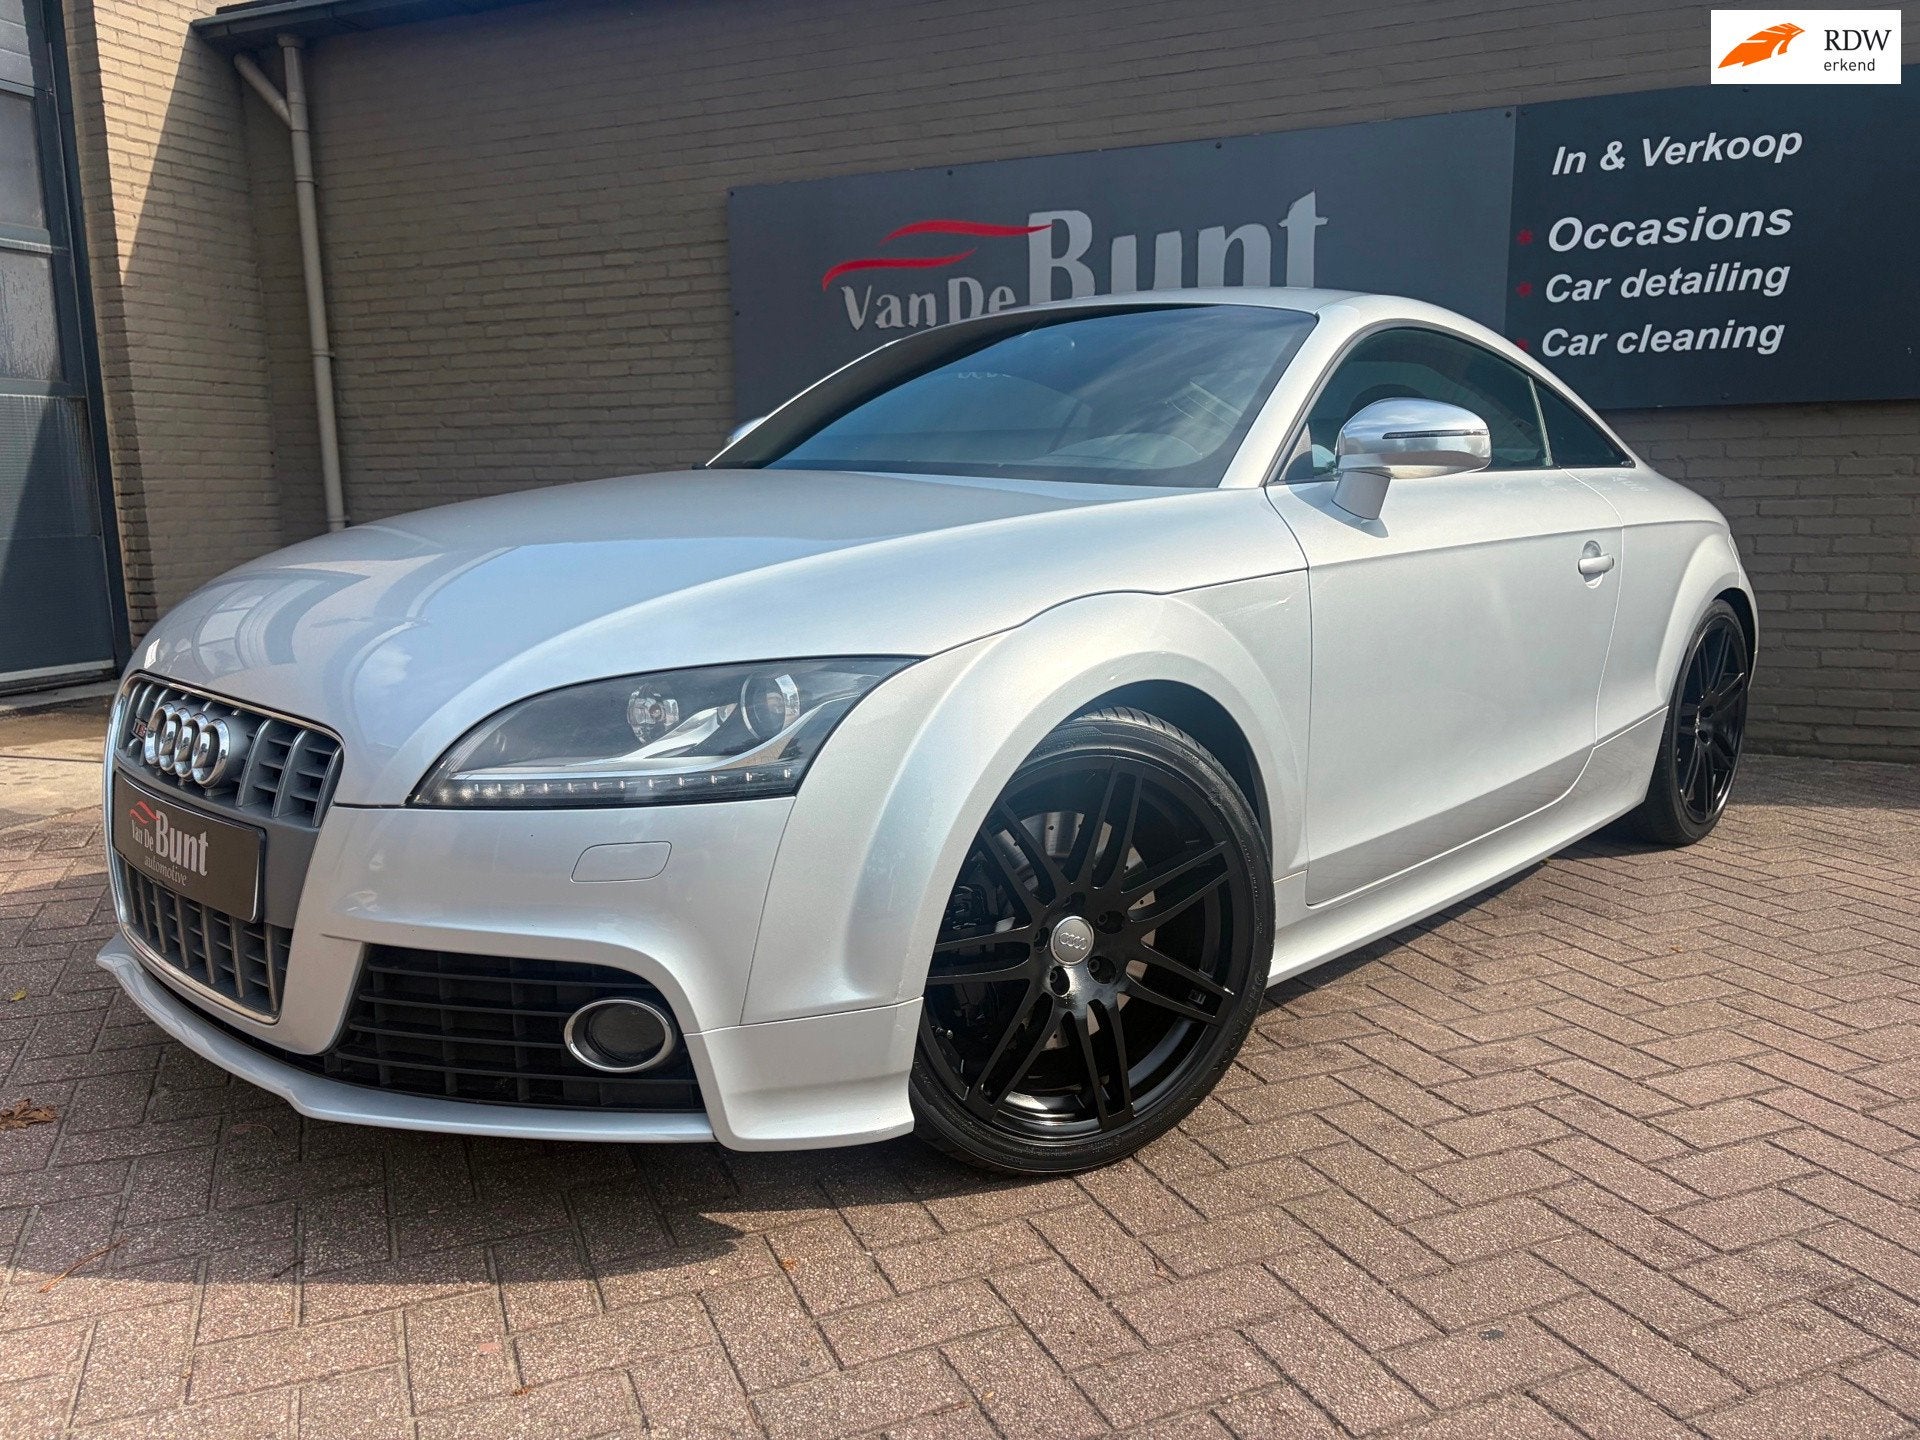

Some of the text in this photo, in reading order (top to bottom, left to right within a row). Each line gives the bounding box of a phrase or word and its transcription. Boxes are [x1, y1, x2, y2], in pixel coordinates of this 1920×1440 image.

[1551, 132, 1803, 175] In & Verkoop
[1028, 191, 1328, 304] Bunt
[1548, 207, 1793, 252] Occasions
[1545, 262, 1791, 303] Car detailing
[1541, 320, 1785, 357] Car cleaning
[155, 811, 208, 876] Bunt
[144, 855, 187, 886] automotive
